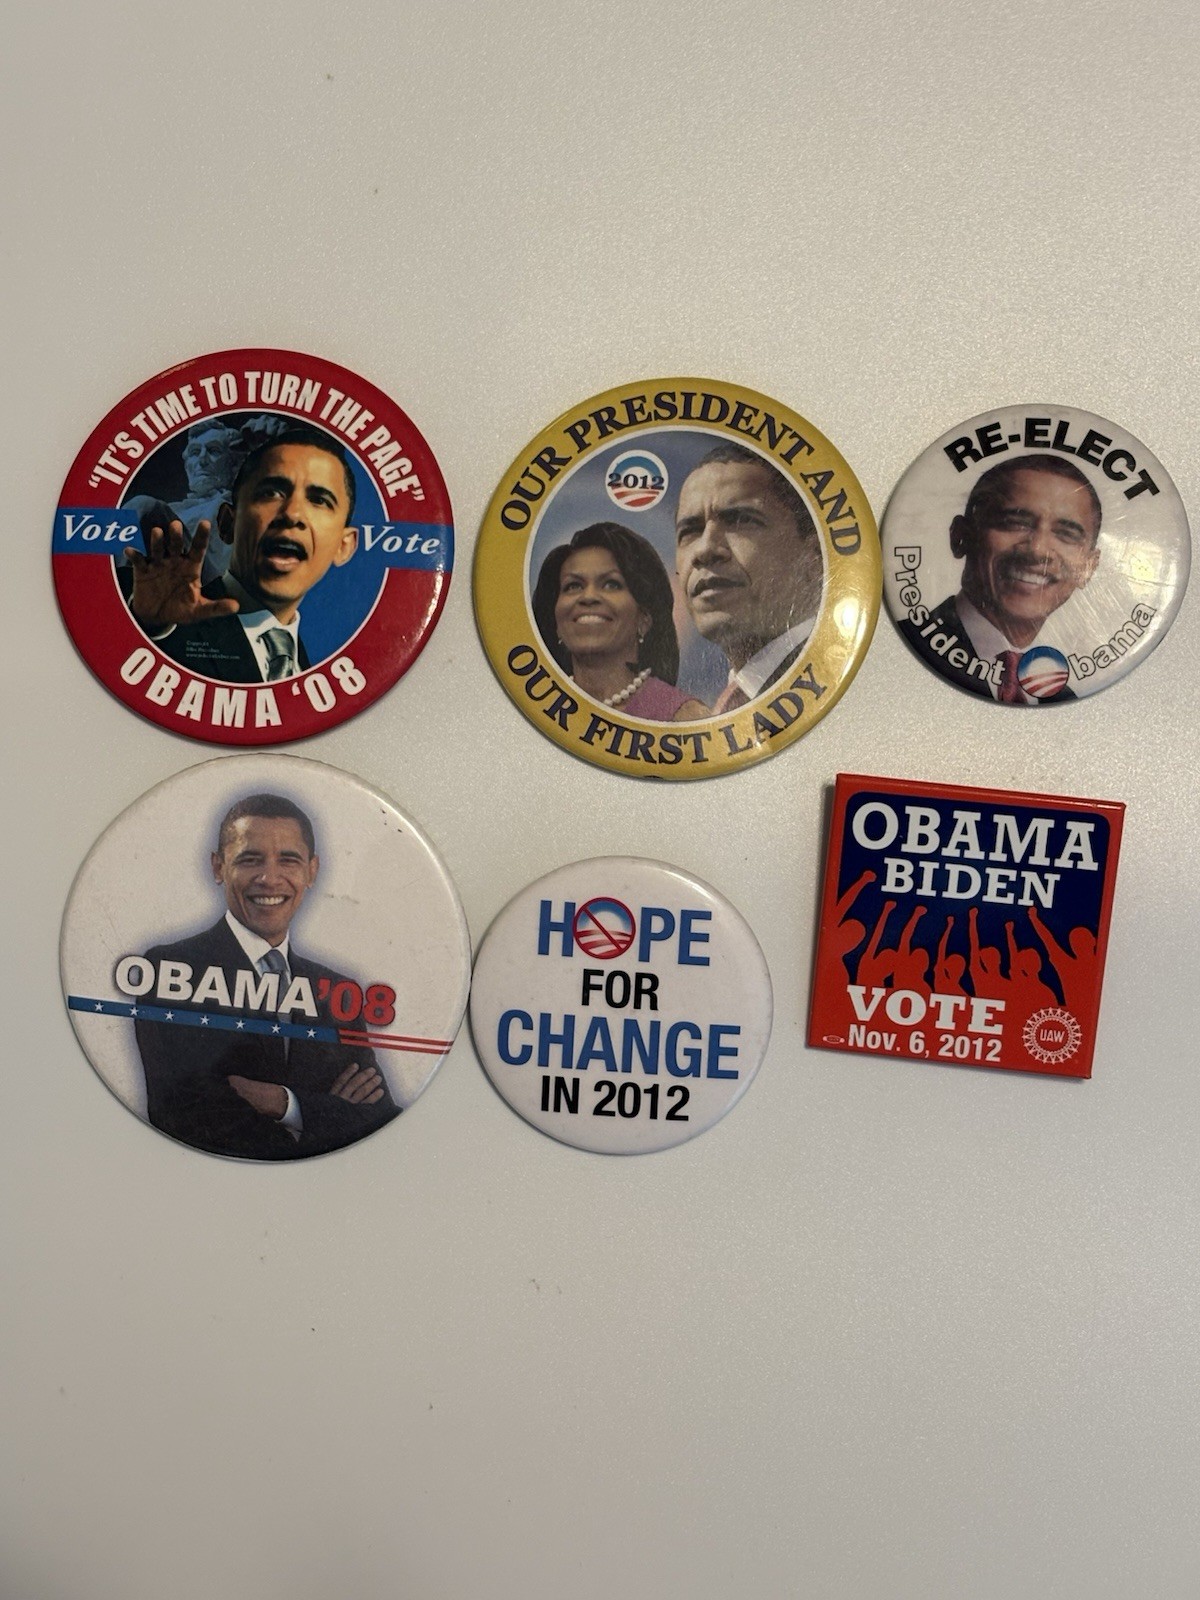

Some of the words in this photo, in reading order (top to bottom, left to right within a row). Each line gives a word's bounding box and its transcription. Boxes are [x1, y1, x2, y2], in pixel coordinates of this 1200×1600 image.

[88, 431, 145, 489] "IT'S
[130, 383, 202, 437] TIME
[200, 371, 237, 408] TO
[244, 371, 322, 410] TURN
[316, 388, 377, 442] THE
[359, 425, 426, 502] PAGE"
[943, 417, 1160, 501] RE-ELECT
[500, 444, 572, 531] OUR
[563, 391, 815, 467] PRESIDENT
[800, 466, 862, 557] AND
[607, 472, 665, 491] 2012
[62, 514, 138, 543] Vote
[361, 523, 441, 555] Vote
[894, 545, 1006, 686] President
[120, 646, 282, 728] OBAMA
[292, 655, 367, 713] '08
[507, 643, 580, 732] OUR
[579, 711, 712, 764] FIRST
[717, 662, 829, 757] LADY
[852, 801, 1099, 872] OBAMA
[881, 857, 1061, 909] BIDEN
[538, 897, 712, 967] HOPE
[581, 968, 660, 1011] FOR
[847, 984, 1006, 1035] VOTE
[497, 1009, 741, 1080] CHANGE
[848, 1024, 901, 1052] Nov.
[909, 1033, 930, 1059] 6,
[938, 1034, 1003, 1062] 2012
[1040, 1029, 1065, 1043] UAW
[541, 1075, 580, 1115] IN
[593, 1080, 690, 1121] 2012
